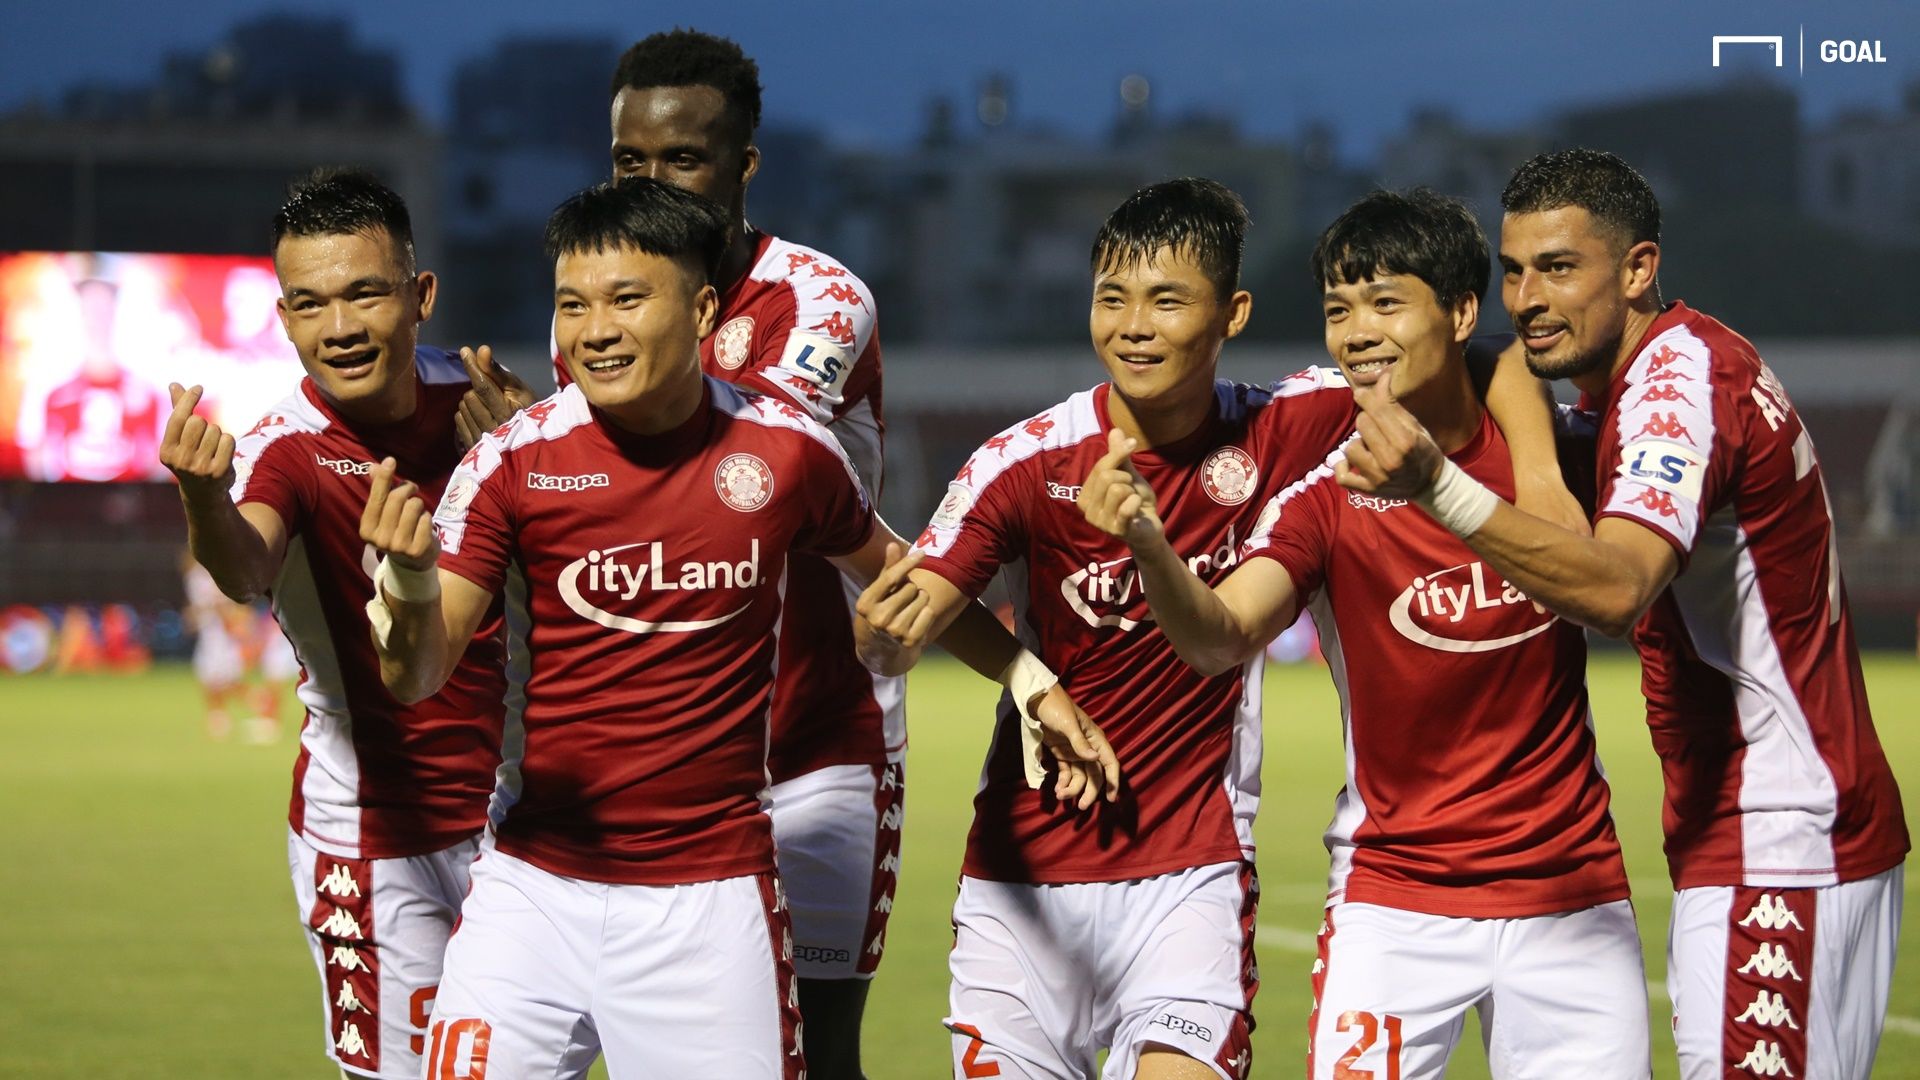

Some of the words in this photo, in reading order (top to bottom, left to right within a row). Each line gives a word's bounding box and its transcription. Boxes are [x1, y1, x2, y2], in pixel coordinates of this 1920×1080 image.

[796, 344, 843, 384] LS
[528, 472, 609, 491] Kappa
[750, 461, 763, 472] CITY
[1630, 450, 1687, 484] LS
[729, 494, 755, 506] FOOTBALL
[1046, 481, 1083, 502] Kap
[557, 538, 759, 634] CityLand
[1061, 523, 1237, 632] Citynd
[1388, 561, 1560, 652] CityLa
[793, 945, 849, 963] appa
[1150, 1013, 1212, 1042] appa
[426, 1018, 493, 1080] 10
[1332, 1010, 1403, 1080] 21
